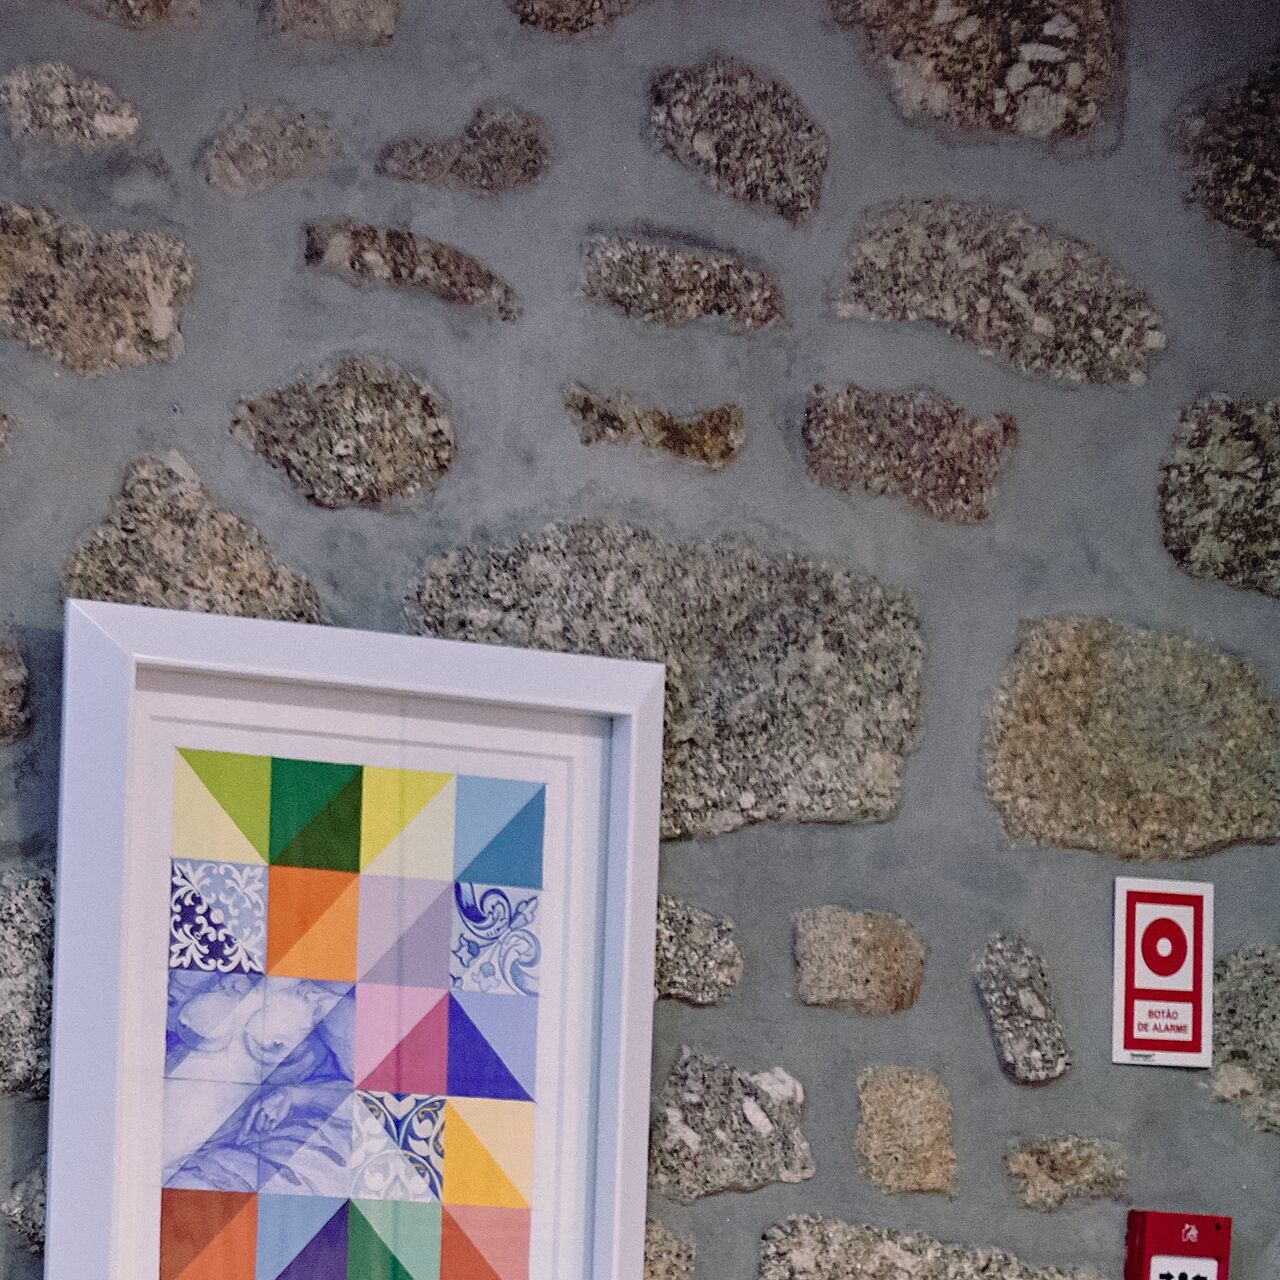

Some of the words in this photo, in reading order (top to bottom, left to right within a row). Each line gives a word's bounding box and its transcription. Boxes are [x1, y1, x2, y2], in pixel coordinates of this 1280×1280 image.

[1148, 1008, 1178, 1020] BOTÃO
[1137, 1021, 1148, 1032] DE
[1152, 1022, 1188, 1034] ALARME
